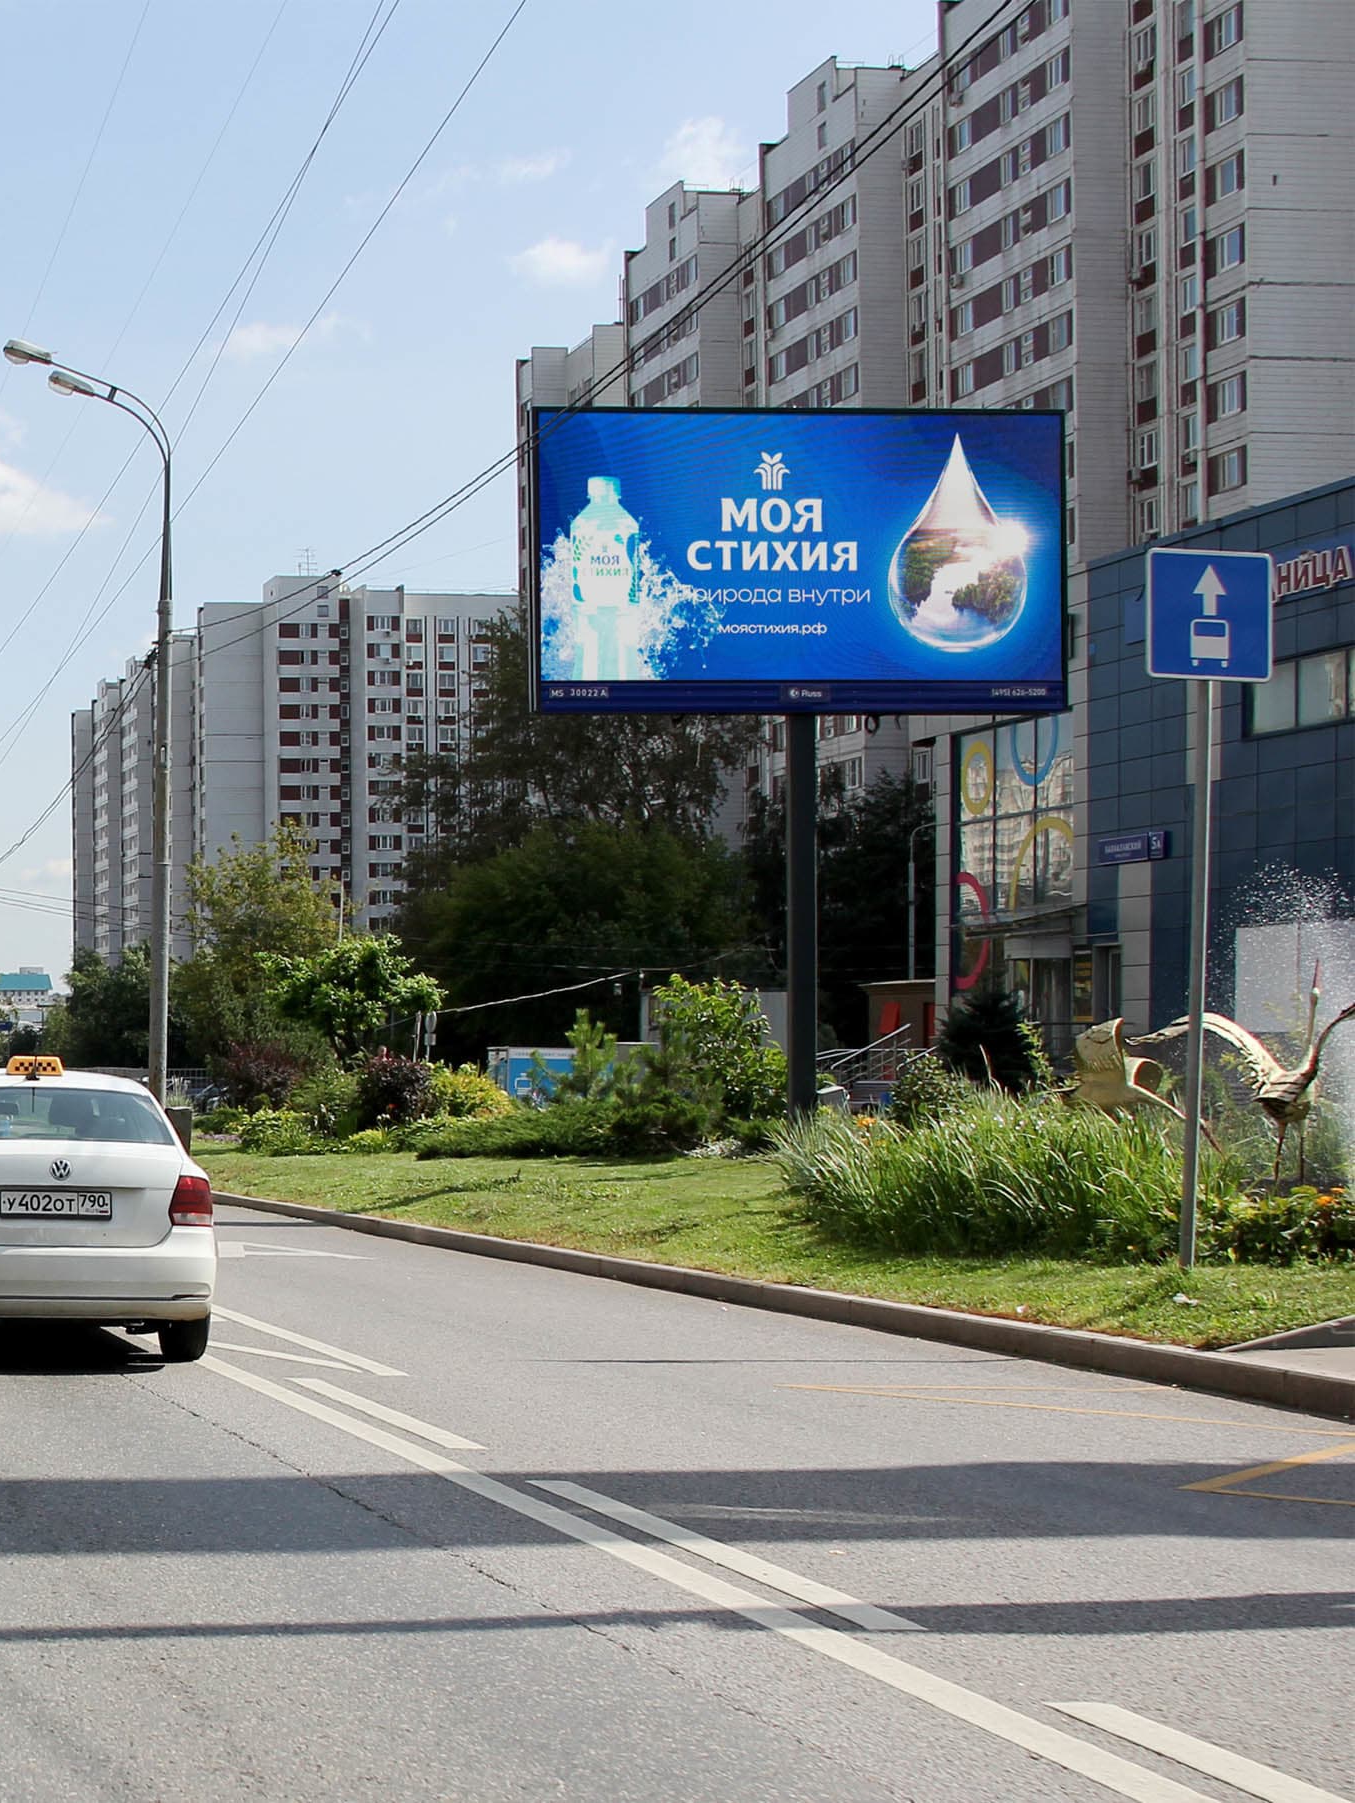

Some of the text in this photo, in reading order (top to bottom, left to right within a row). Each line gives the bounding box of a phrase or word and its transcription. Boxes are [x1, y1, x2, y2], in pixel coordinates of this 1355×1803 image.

[720, 497, 823, 533] МОЯ
[590, 555, 620, 565] МОЯ
[686, 540, 858, 572] СТИХИЯ
[1271, 545, 1353, 603] НИЦА
[788, 588, 871, 606] внутри
[718, 621, 828, 636] моястихия.рф
